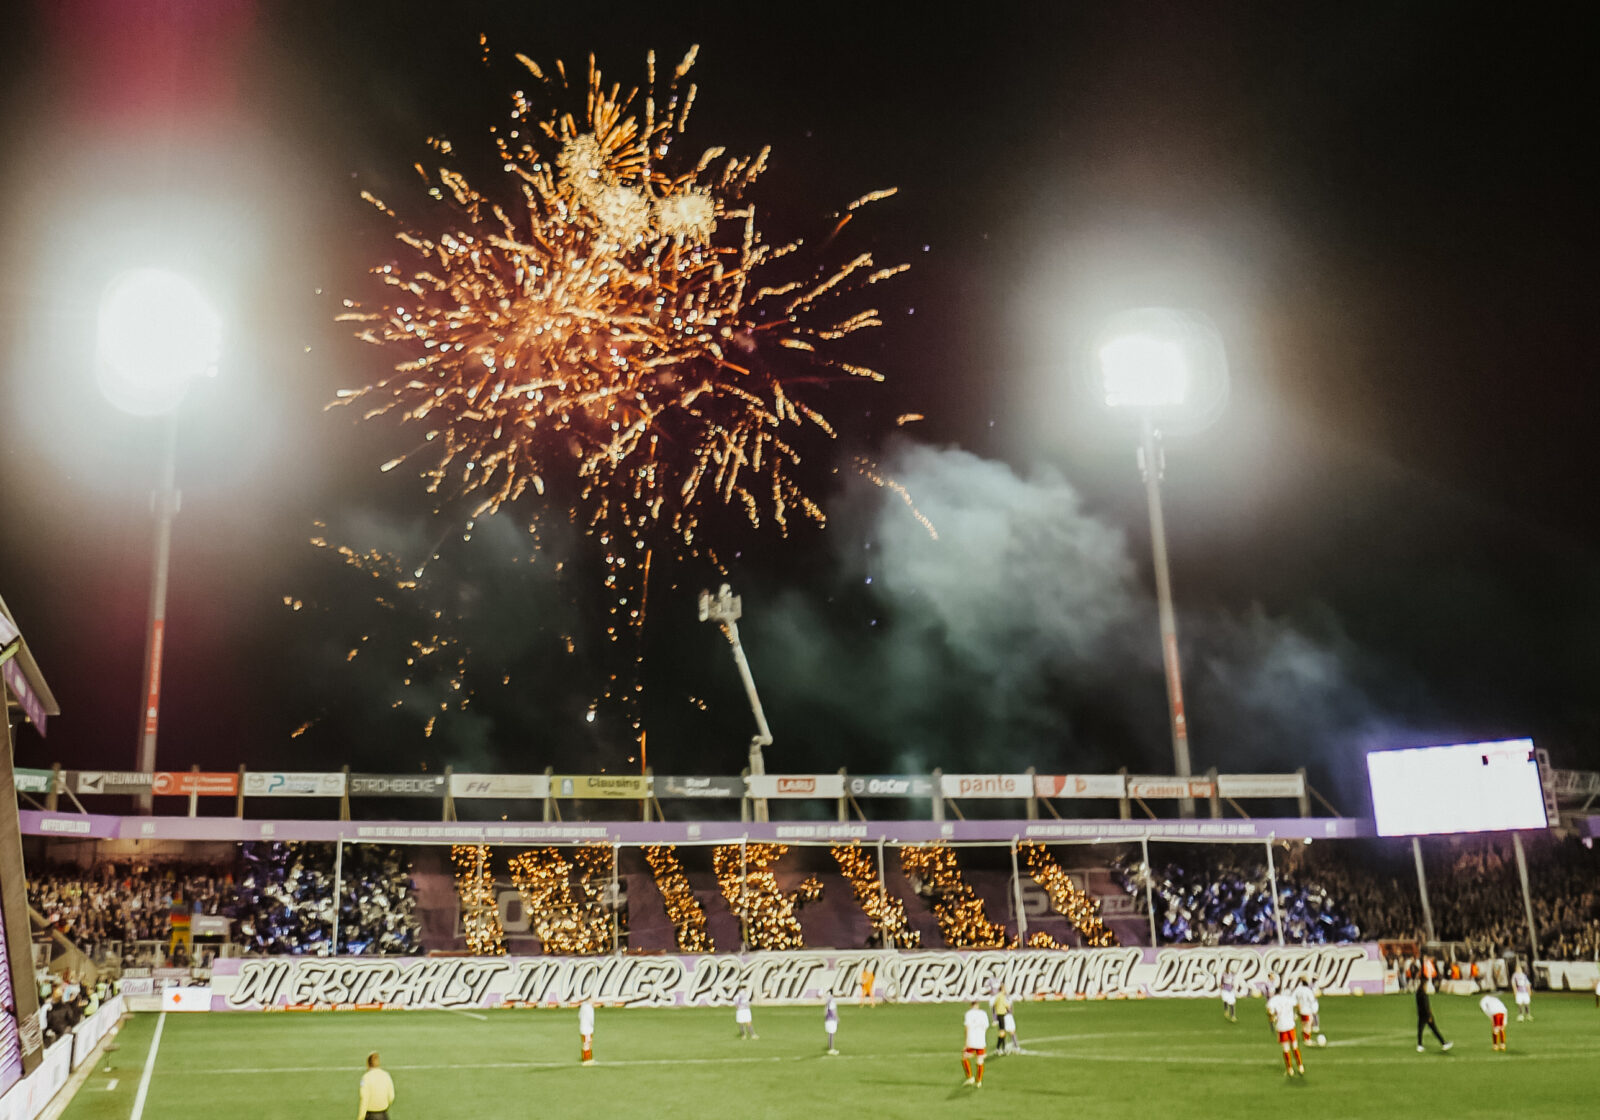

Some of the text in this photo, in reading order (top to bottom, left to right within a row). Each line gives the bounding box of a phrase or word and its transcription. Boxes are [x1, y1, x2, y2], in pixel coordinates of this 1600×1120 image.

[588, 777, 640, 790] Clausing
[960, 776, 1017, 795] pante
[505, 961, 559, 1001] IN
[562, 958, 683, 1005] VOLLER
[690, 957, 825, 1002] PRACHT
